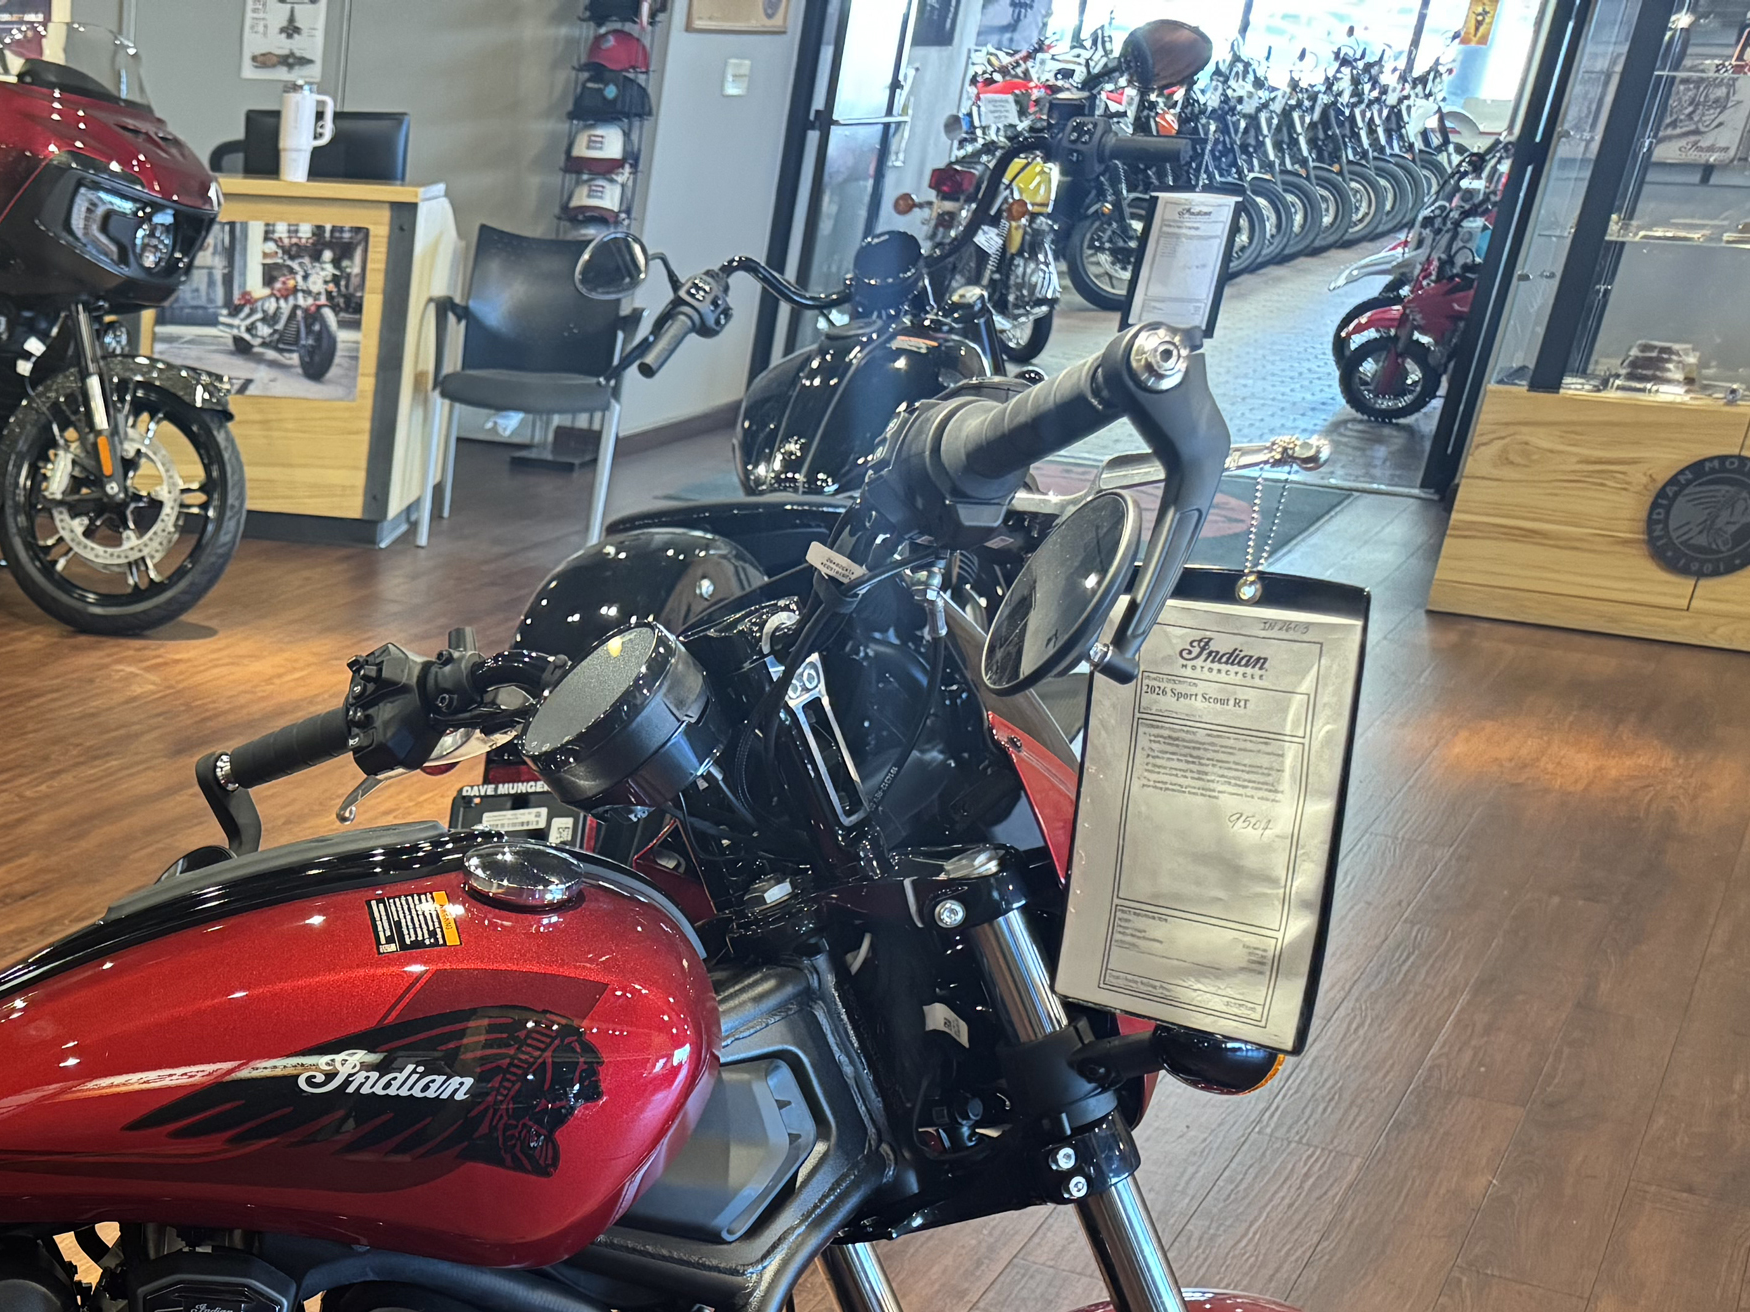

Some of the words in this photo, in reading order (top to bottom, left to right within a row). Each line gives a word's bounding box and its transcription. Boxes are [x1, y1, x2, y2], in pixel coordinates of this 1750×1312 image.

[1178, 636, 1269, 672] Indian
[1181, 662, 1265, 682] MOTORCYCLE
[1143, 683, 1168, 697] 2026
[1169, 689, 1199, 702] Sport
[1200, 692, 1231, 708] Scout
[1233, 697, 1251, 710] RT
[461, 784, 496, 797] DAVE
[297, 1049, 475, 1101] Indian
